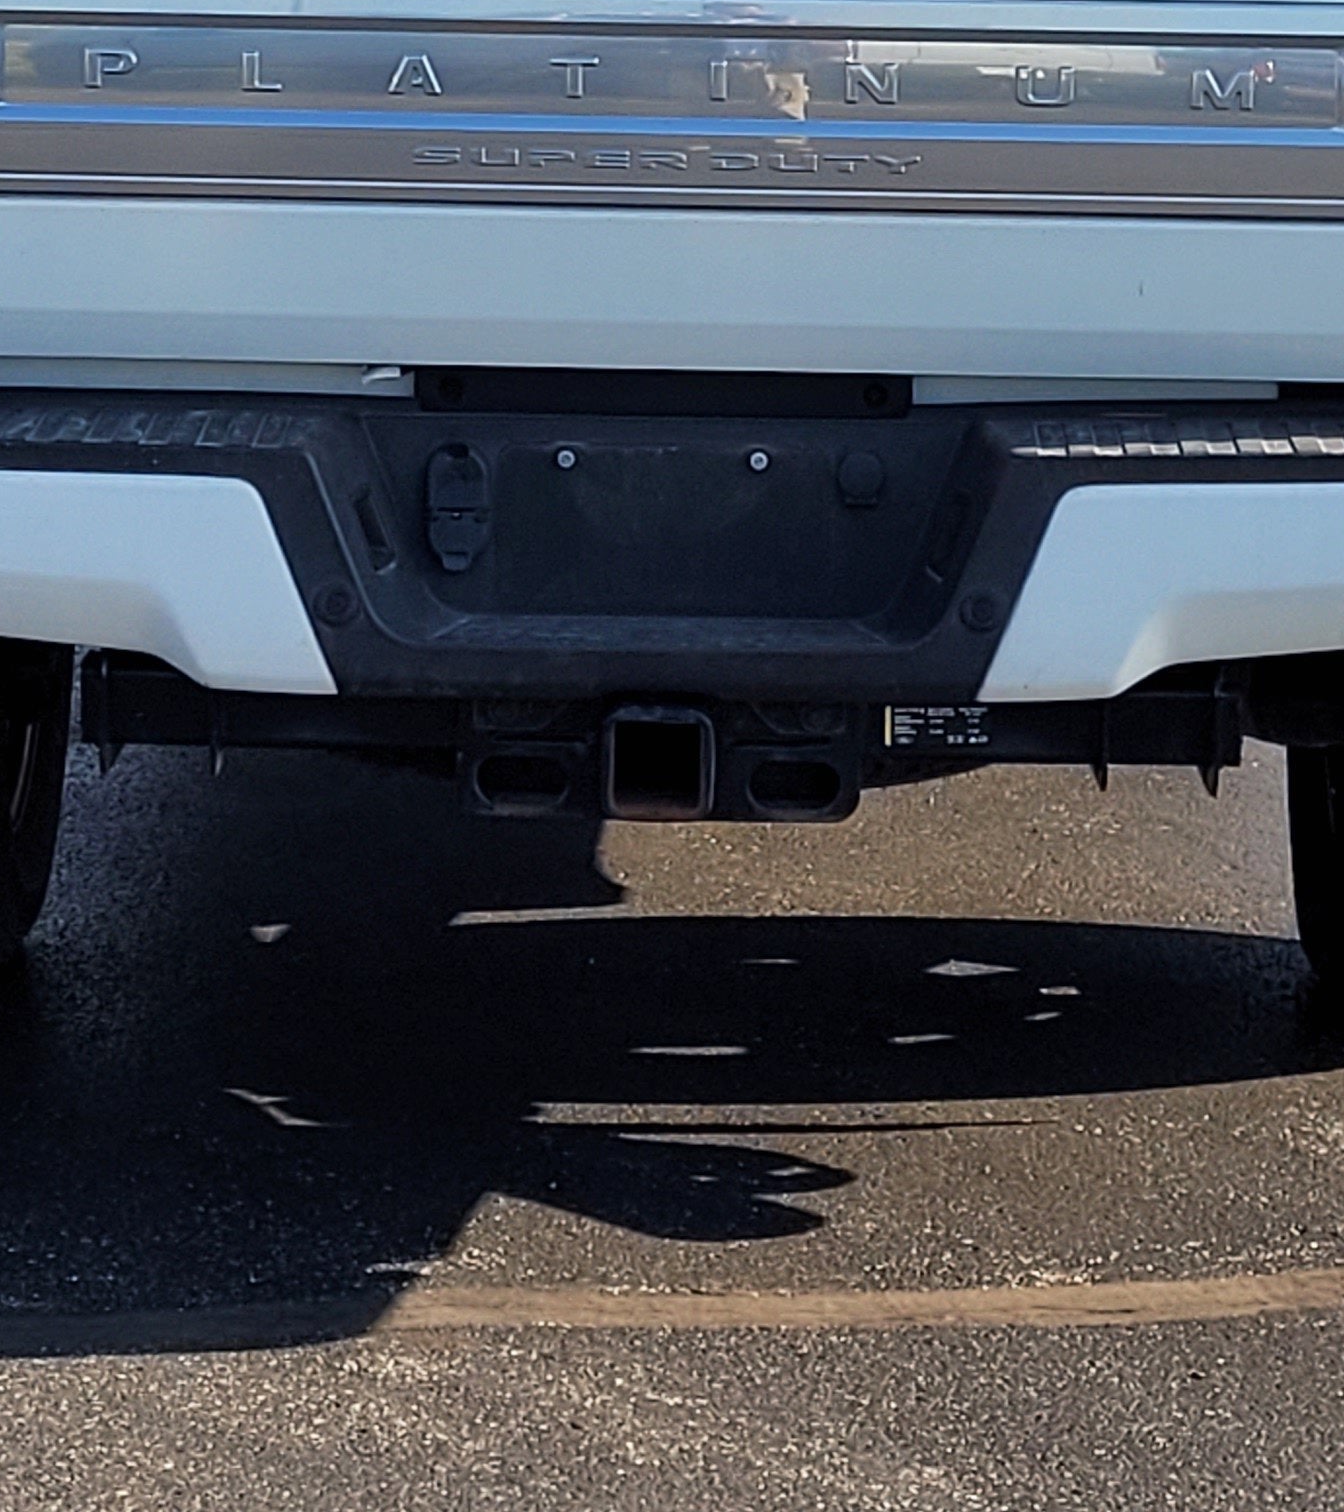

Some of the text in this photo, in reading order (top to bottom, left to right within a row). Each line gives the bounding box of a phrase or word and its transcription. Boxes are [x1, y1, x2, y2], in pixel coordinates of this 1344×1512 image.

[83, 47, 1257, 111] PLATINUM
[411, 145, 922, 174] SUPER DUTY
